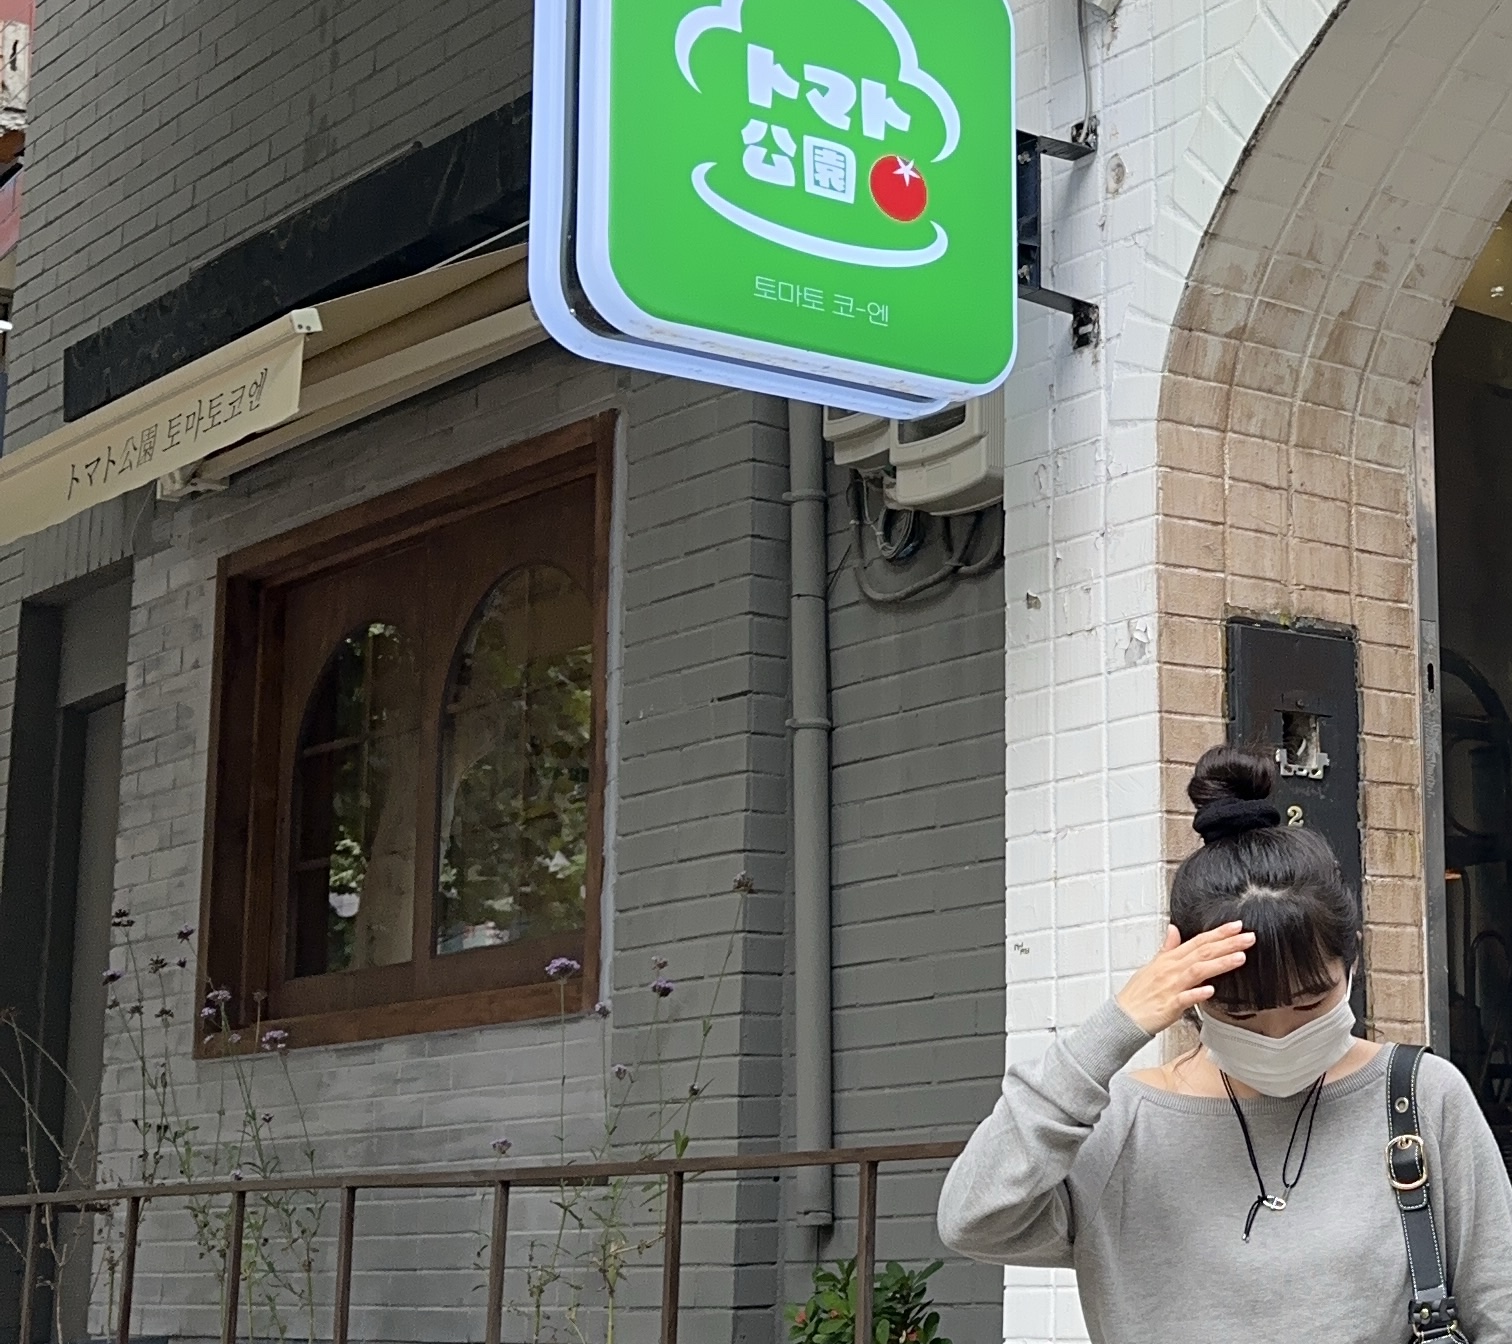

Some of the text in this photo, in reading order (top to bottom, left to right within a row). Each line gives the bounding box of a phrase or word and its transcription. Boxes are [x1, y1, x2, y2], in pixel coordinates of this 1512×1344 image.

[747, 44, 911, 140] トマト
[741, 119, 856, 204] 公園
[753, 275, 890, 328] 토마토 코-엔
[67, 367, 269, 501] トマト公園 토마토코엔
